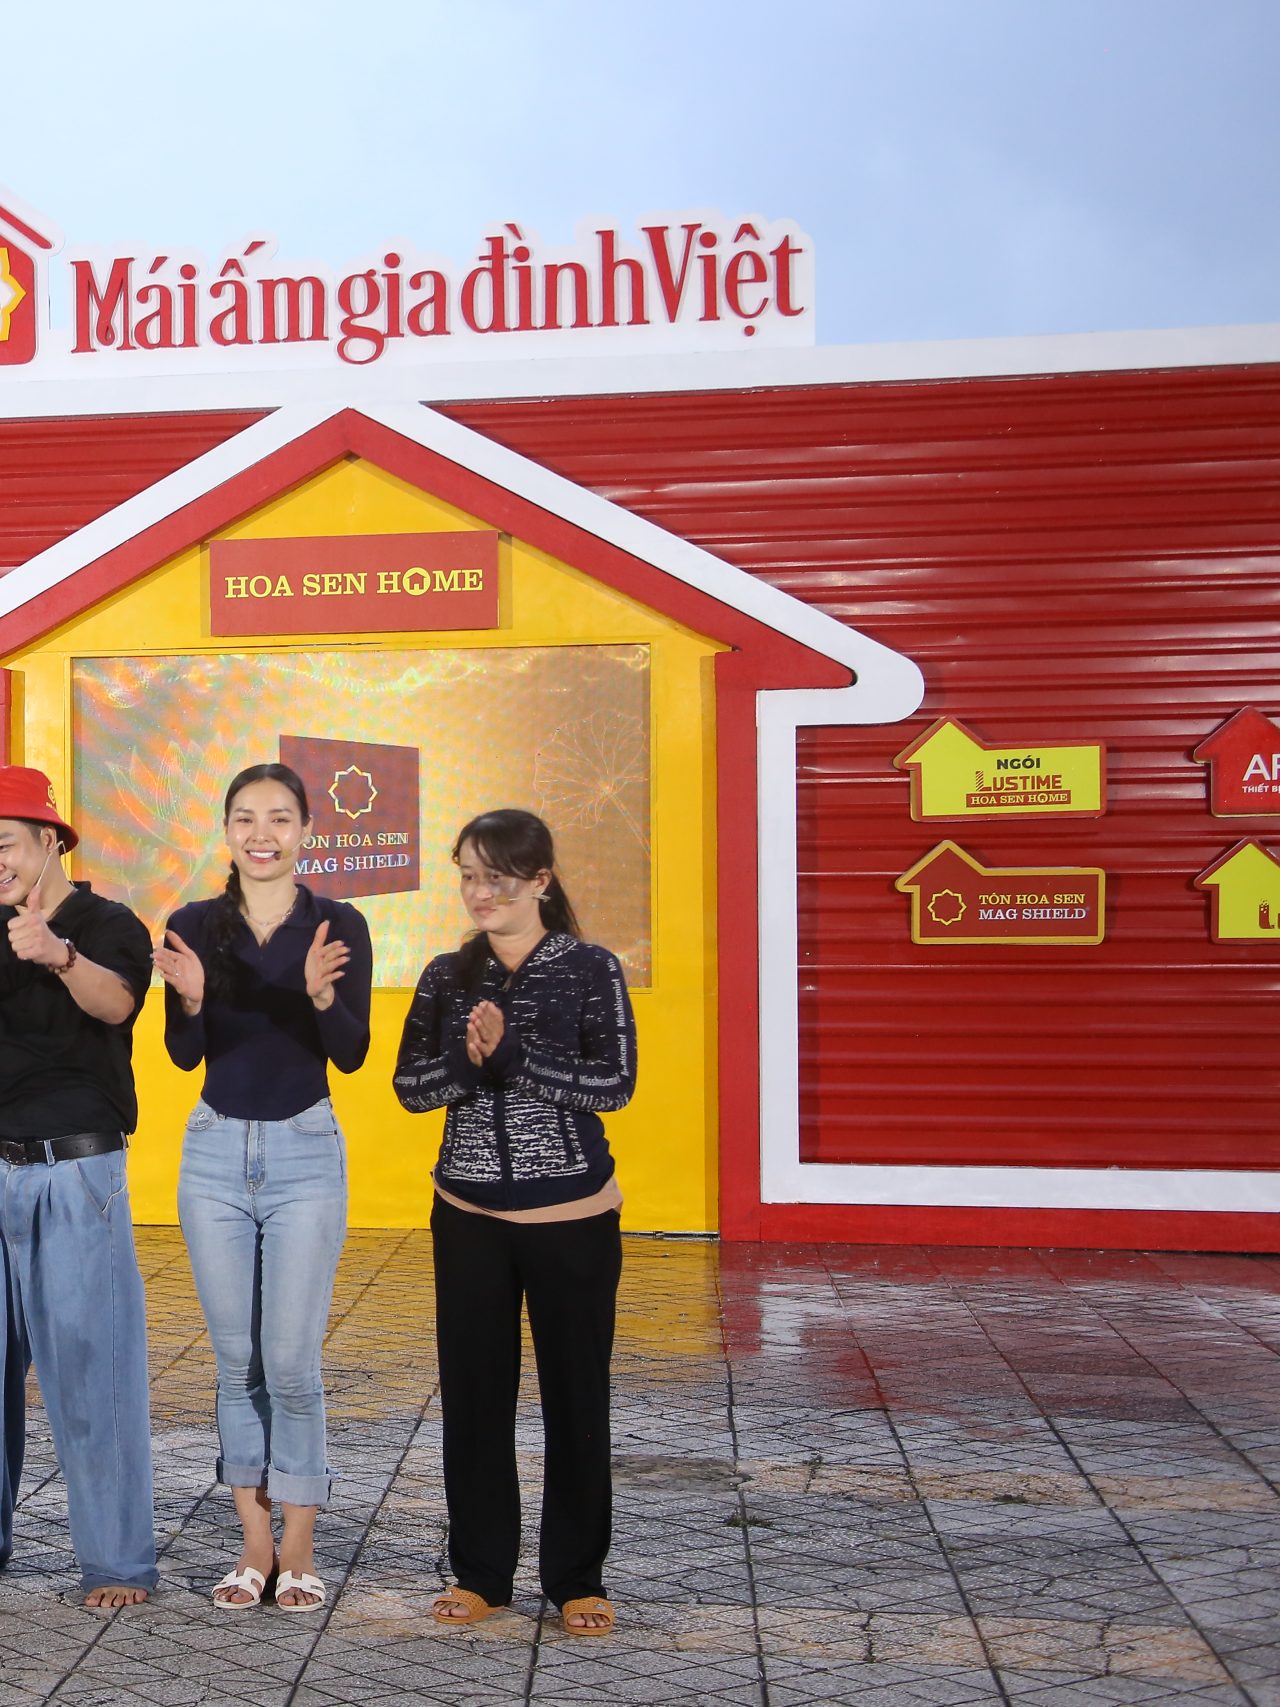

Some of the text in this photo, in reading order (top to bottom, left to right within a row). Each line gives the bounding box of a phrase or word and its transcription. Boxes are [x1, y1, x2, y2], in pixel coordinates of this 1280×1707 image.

[70, 223, 805, 366] Mái ấm gia đình Việt
[224, 567, 483, 598] HOA SEN HOME
[996, 755, 1041, 770] NGÓI
[975, 771, 1062, 792] LUSTIME
[1242, 782, 1269, 793] THIẾT
[971, 793, 1068, 805] HOA SEN HOME
[336, 834, 373, 848] HOA
[377, 832, 409, 846] SEN
[294, 853, 410, 875] MAG SHIELD
[979, 893, 1086, 905] TÔN HOA SEN
[979, 908, 1087, 920] MAG SHIELD
